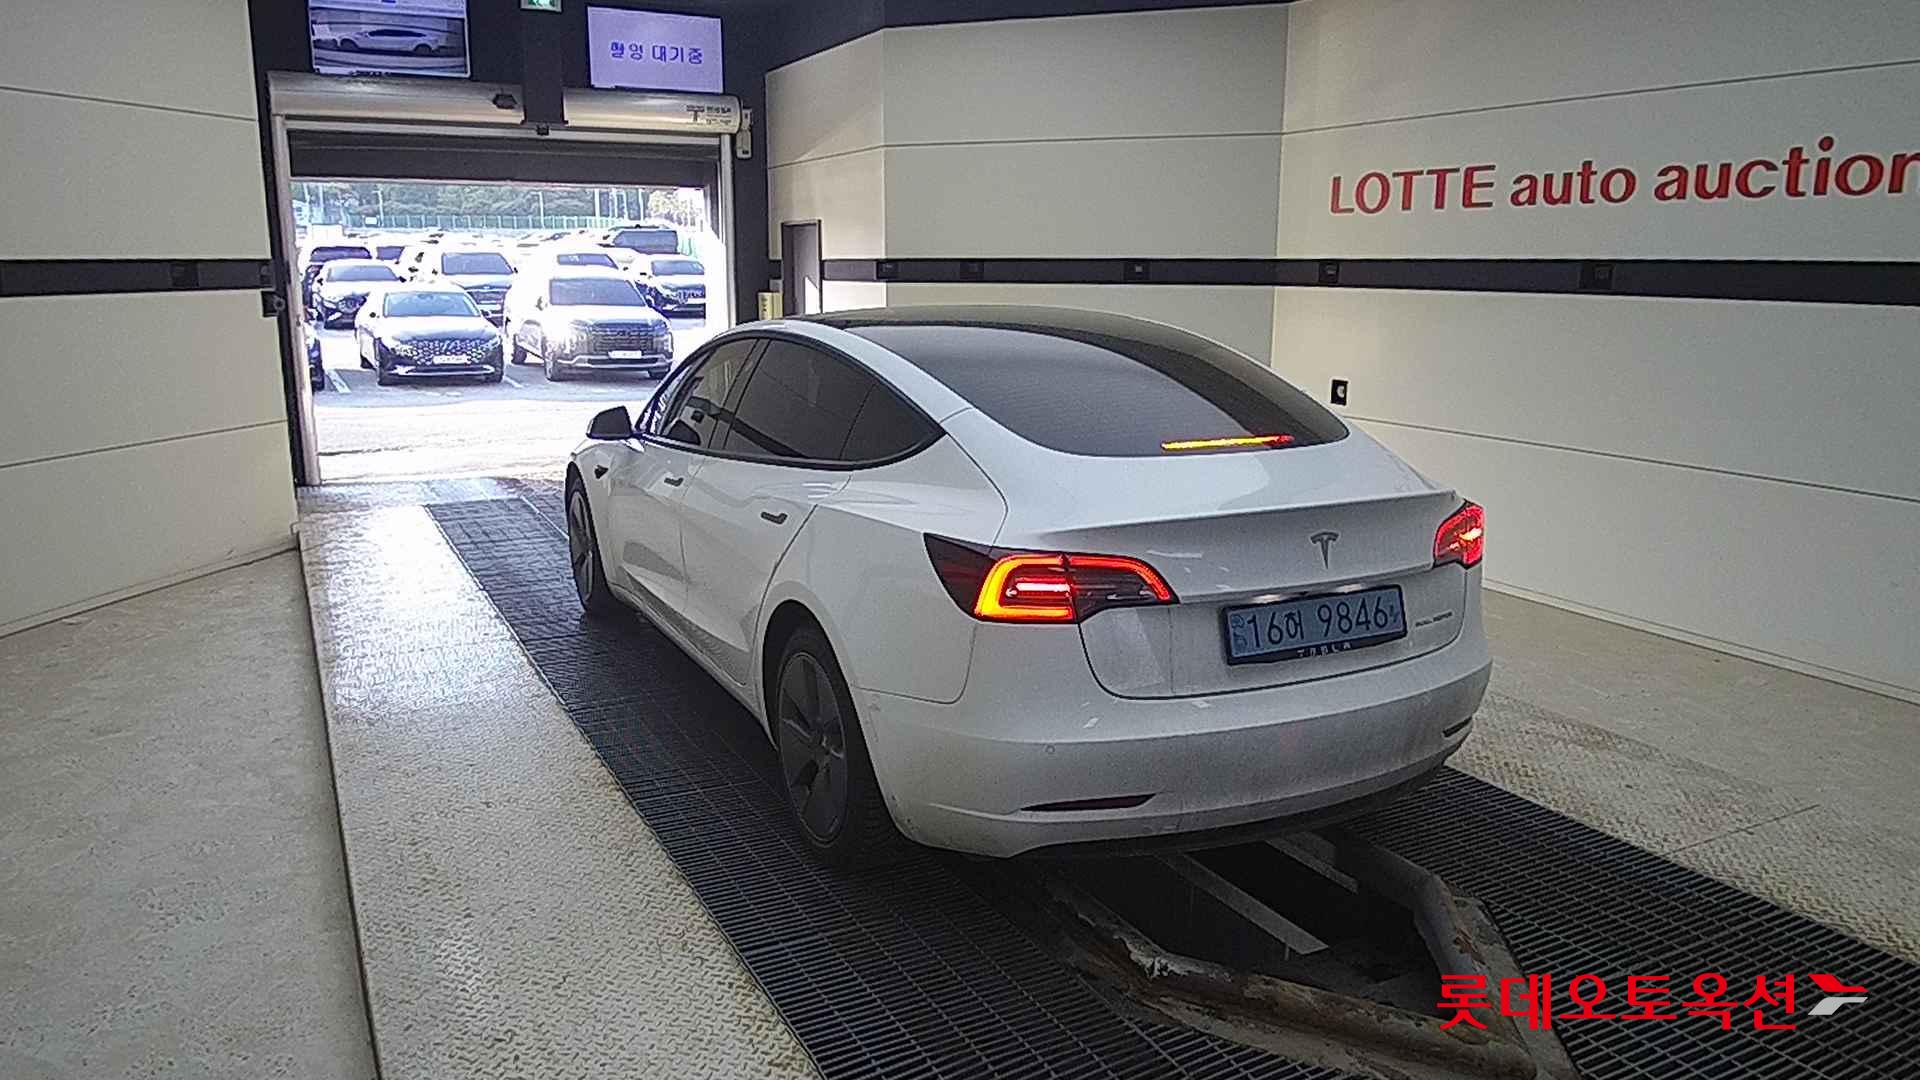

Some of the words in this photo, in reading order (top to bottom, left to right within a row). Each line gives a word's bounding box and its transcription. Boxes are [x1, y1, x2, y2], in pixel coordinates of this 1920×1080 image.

[652, 44, 703, 65] 대기중
[1330, 164, 1497, 215] LOTTE
[1510, 160, 1637, 206] auto
[1317, 596, 1389, 639] 9846
